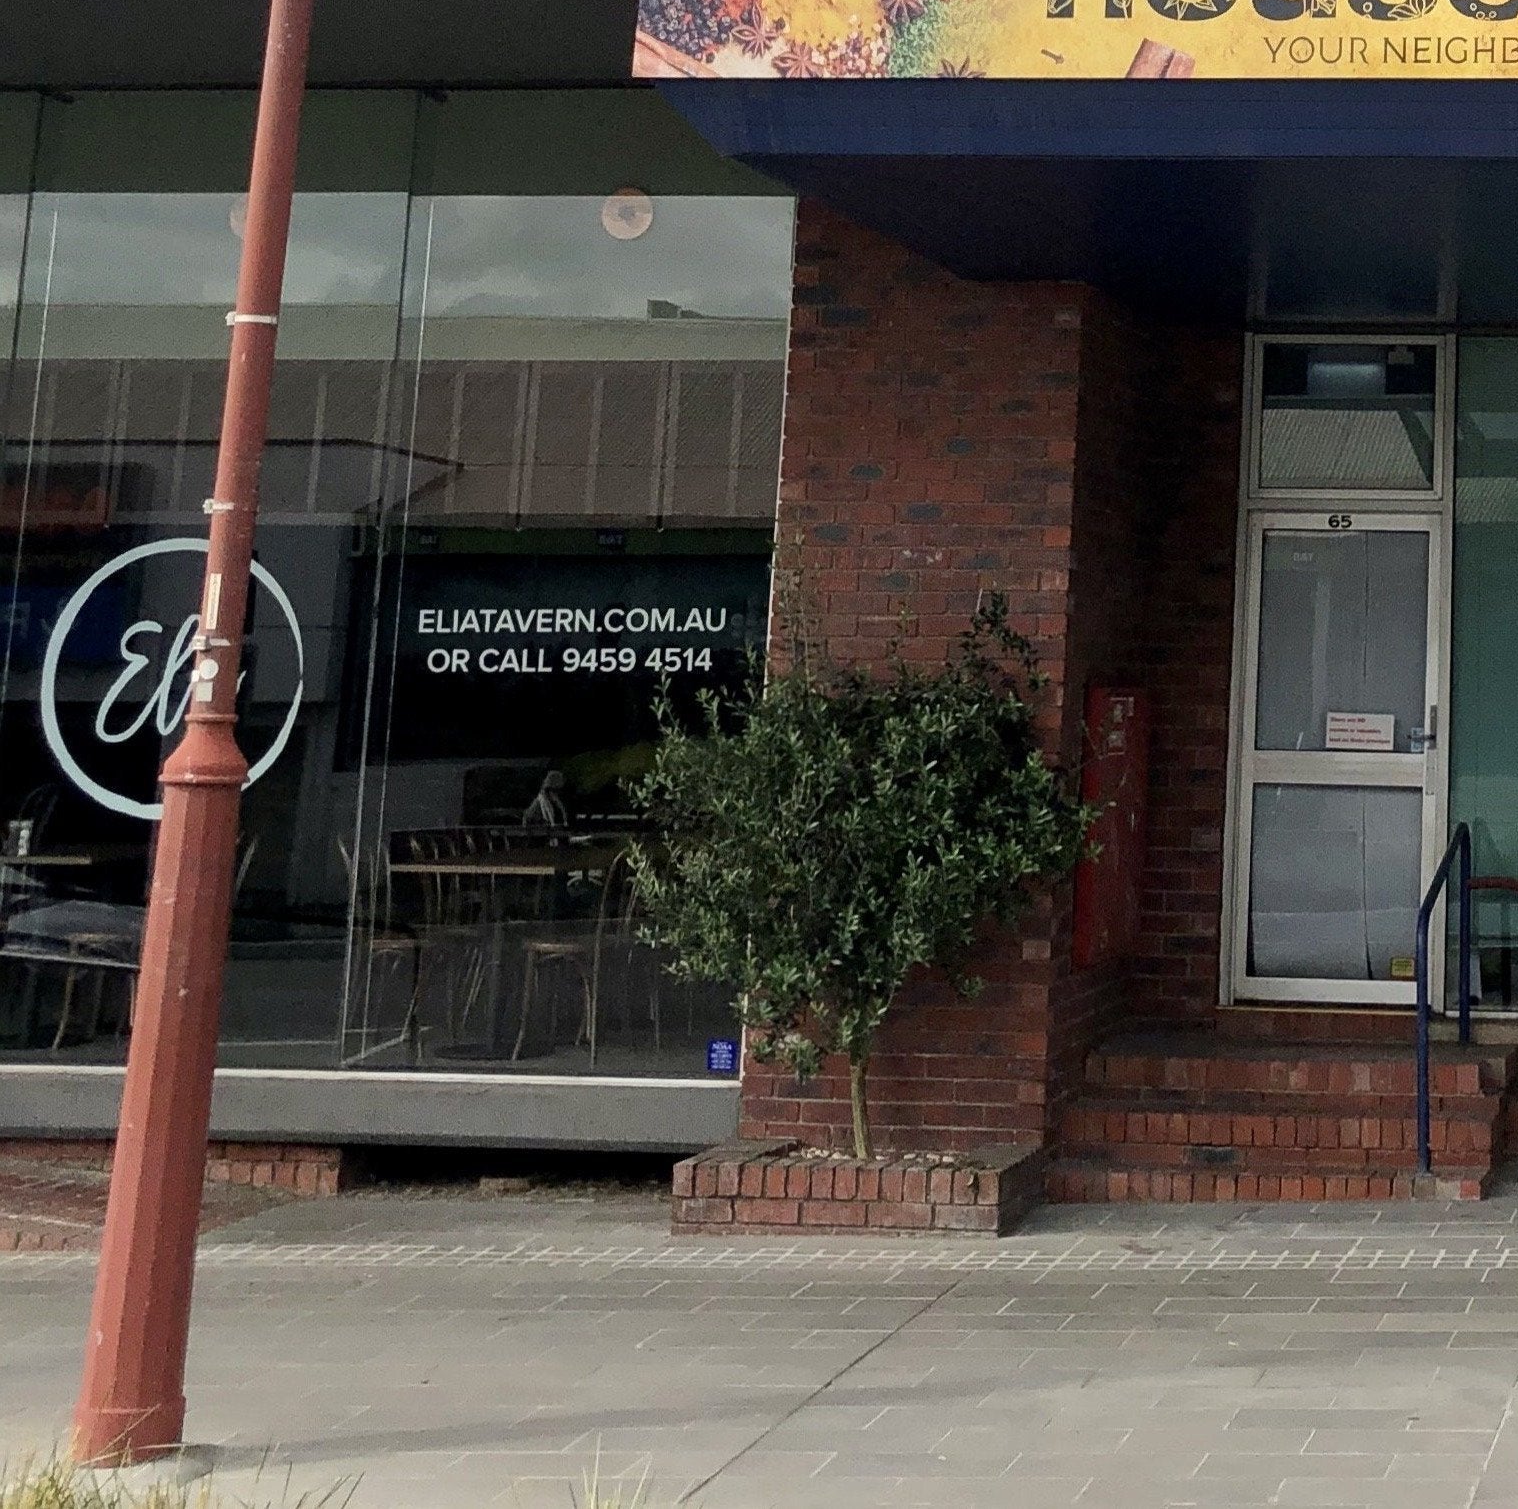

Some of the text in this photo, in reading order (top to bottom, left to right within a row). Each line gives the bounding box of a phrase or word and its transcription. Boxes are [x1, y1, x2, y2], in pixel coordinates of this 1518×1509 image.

[1262, 36, 1368, 65] YOUR
[1327, 514, 1353, 529] 65
[417, 607, 727, 634] ELIATAVERN.COM.AU
[426, 647, 713, 673] OR CALL 9459 4514
